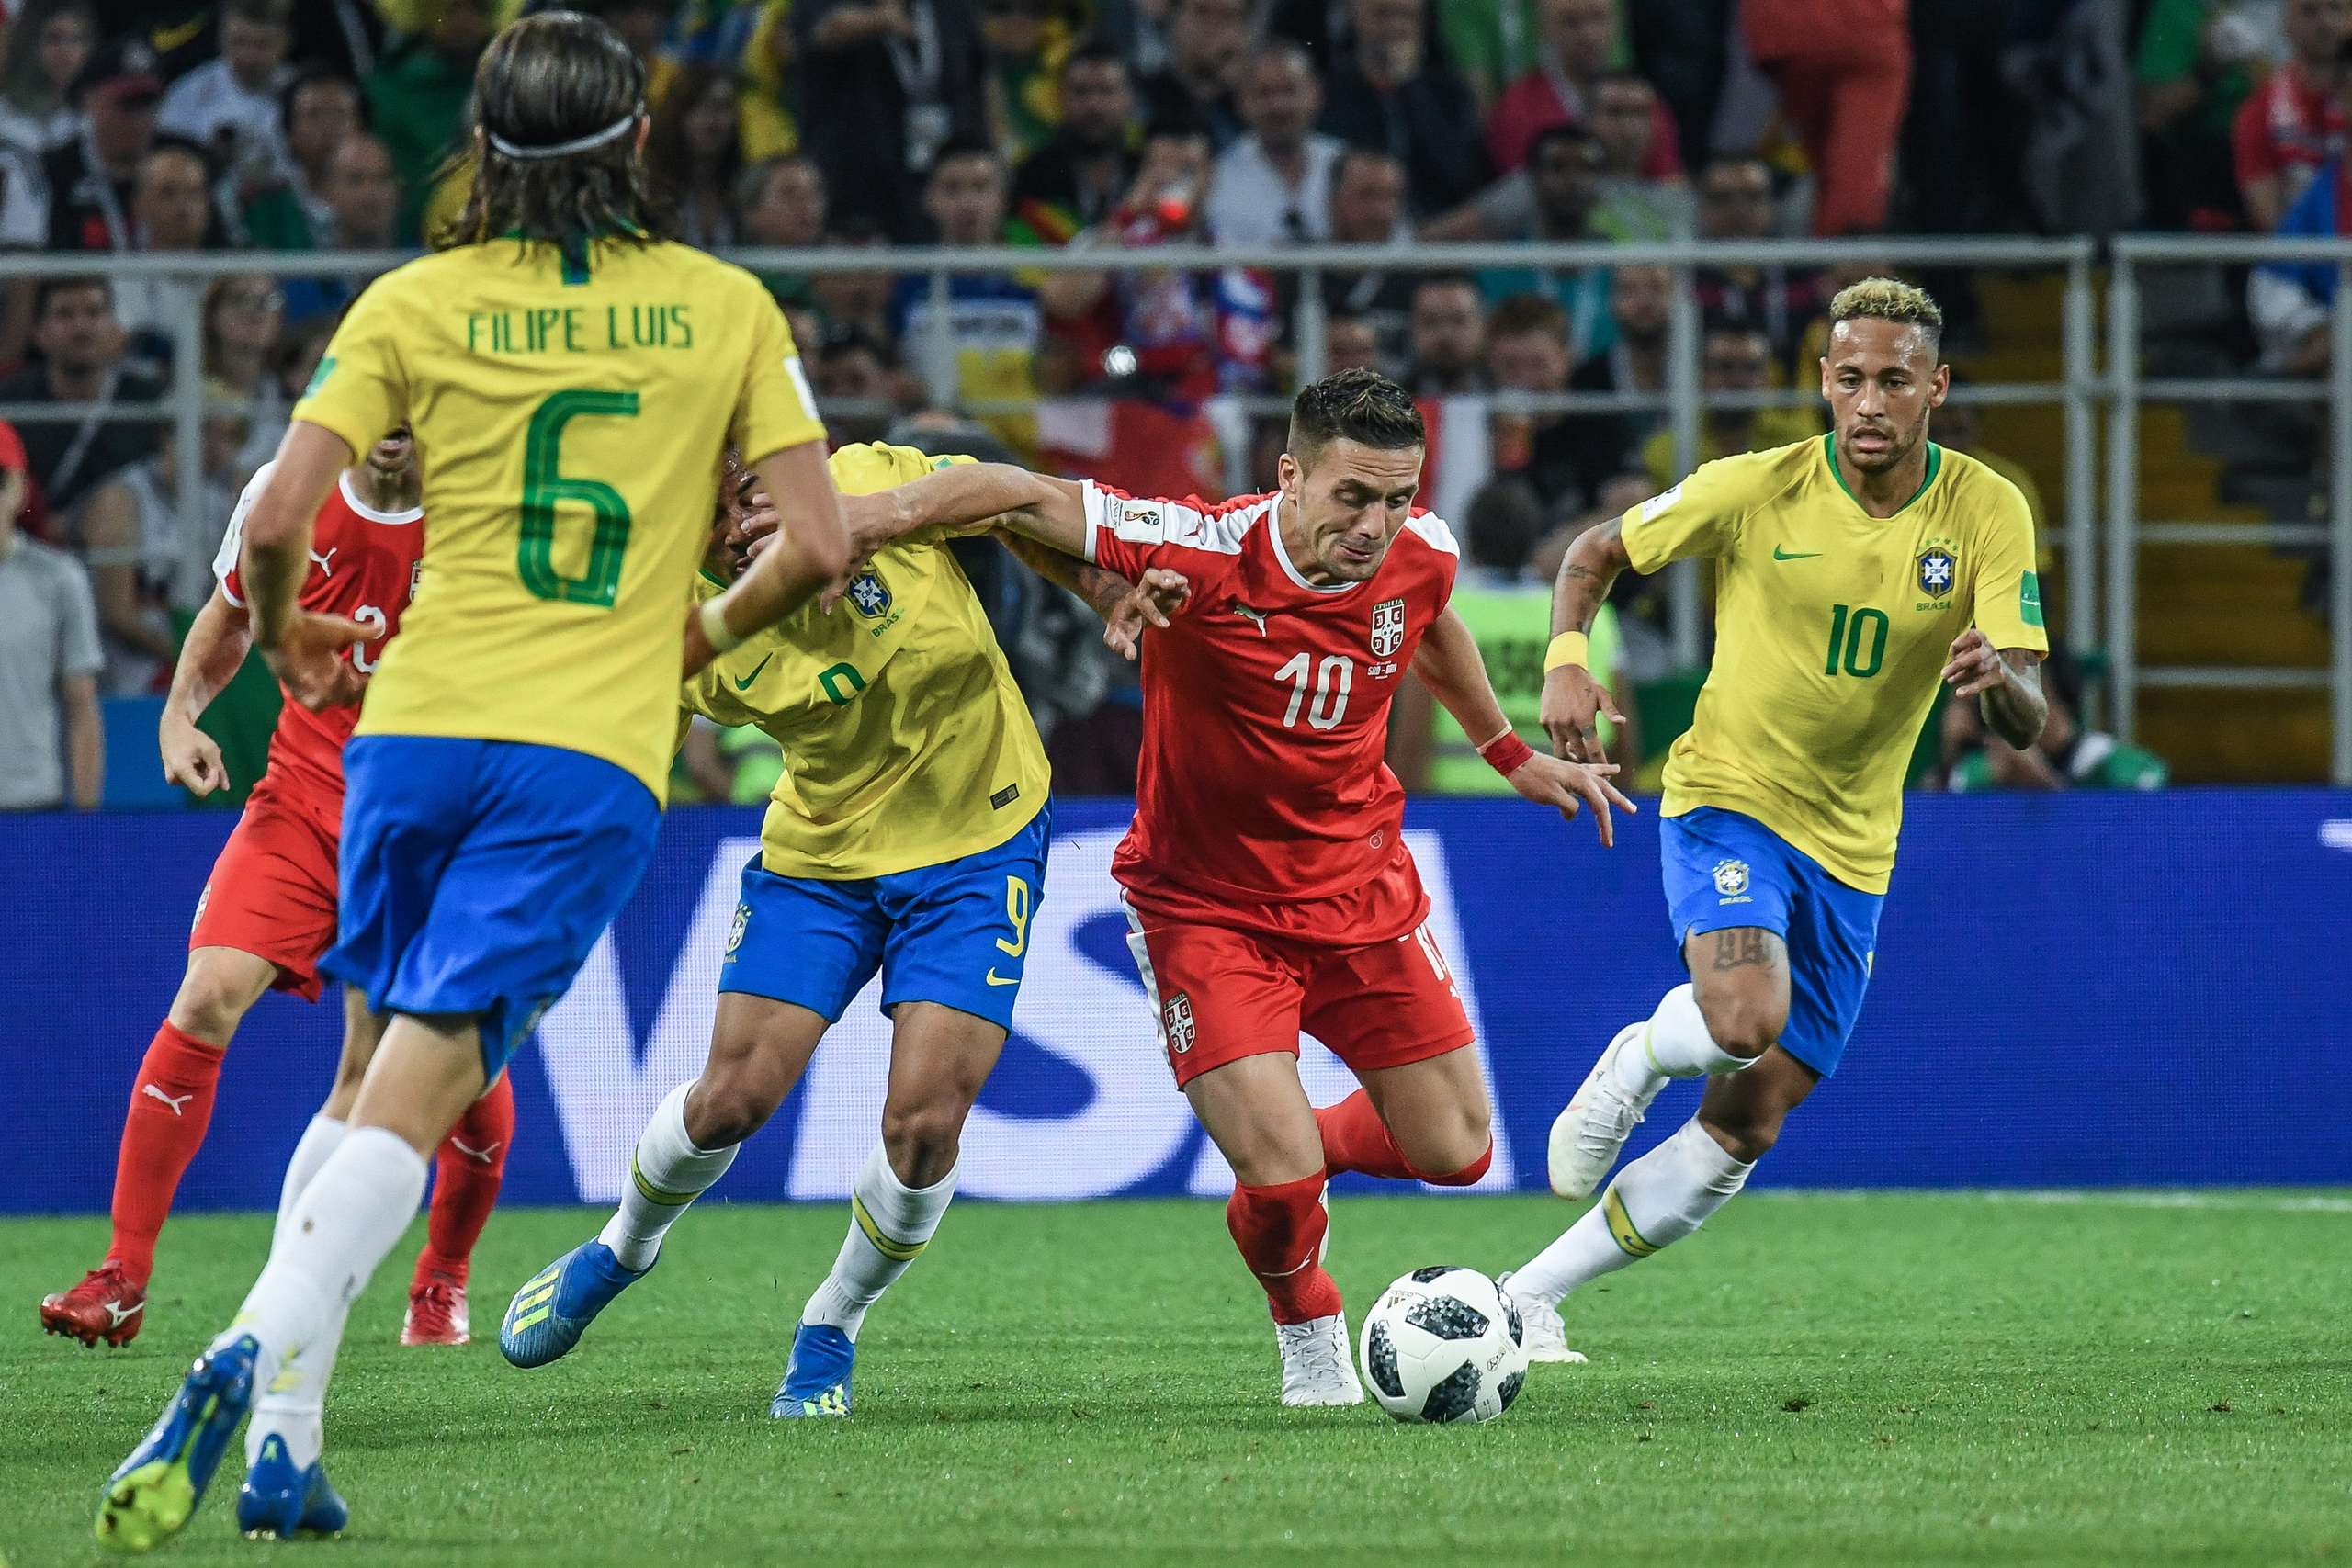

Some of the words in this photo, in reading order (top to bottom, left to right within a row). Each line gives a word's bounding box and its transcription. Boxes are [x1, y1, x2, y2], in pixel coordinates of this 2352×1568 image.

[468, 306, 588, 354] FILIPE
[607, 304, 694, 350] LUIS
[516, 388, 640, 609] 6
[861, 587, 874, 599] CBF
[1824, 603, 1890, 679] 10
[1273, 651, 1354, 730] 10
[995, 874, 1029, 958] 9
